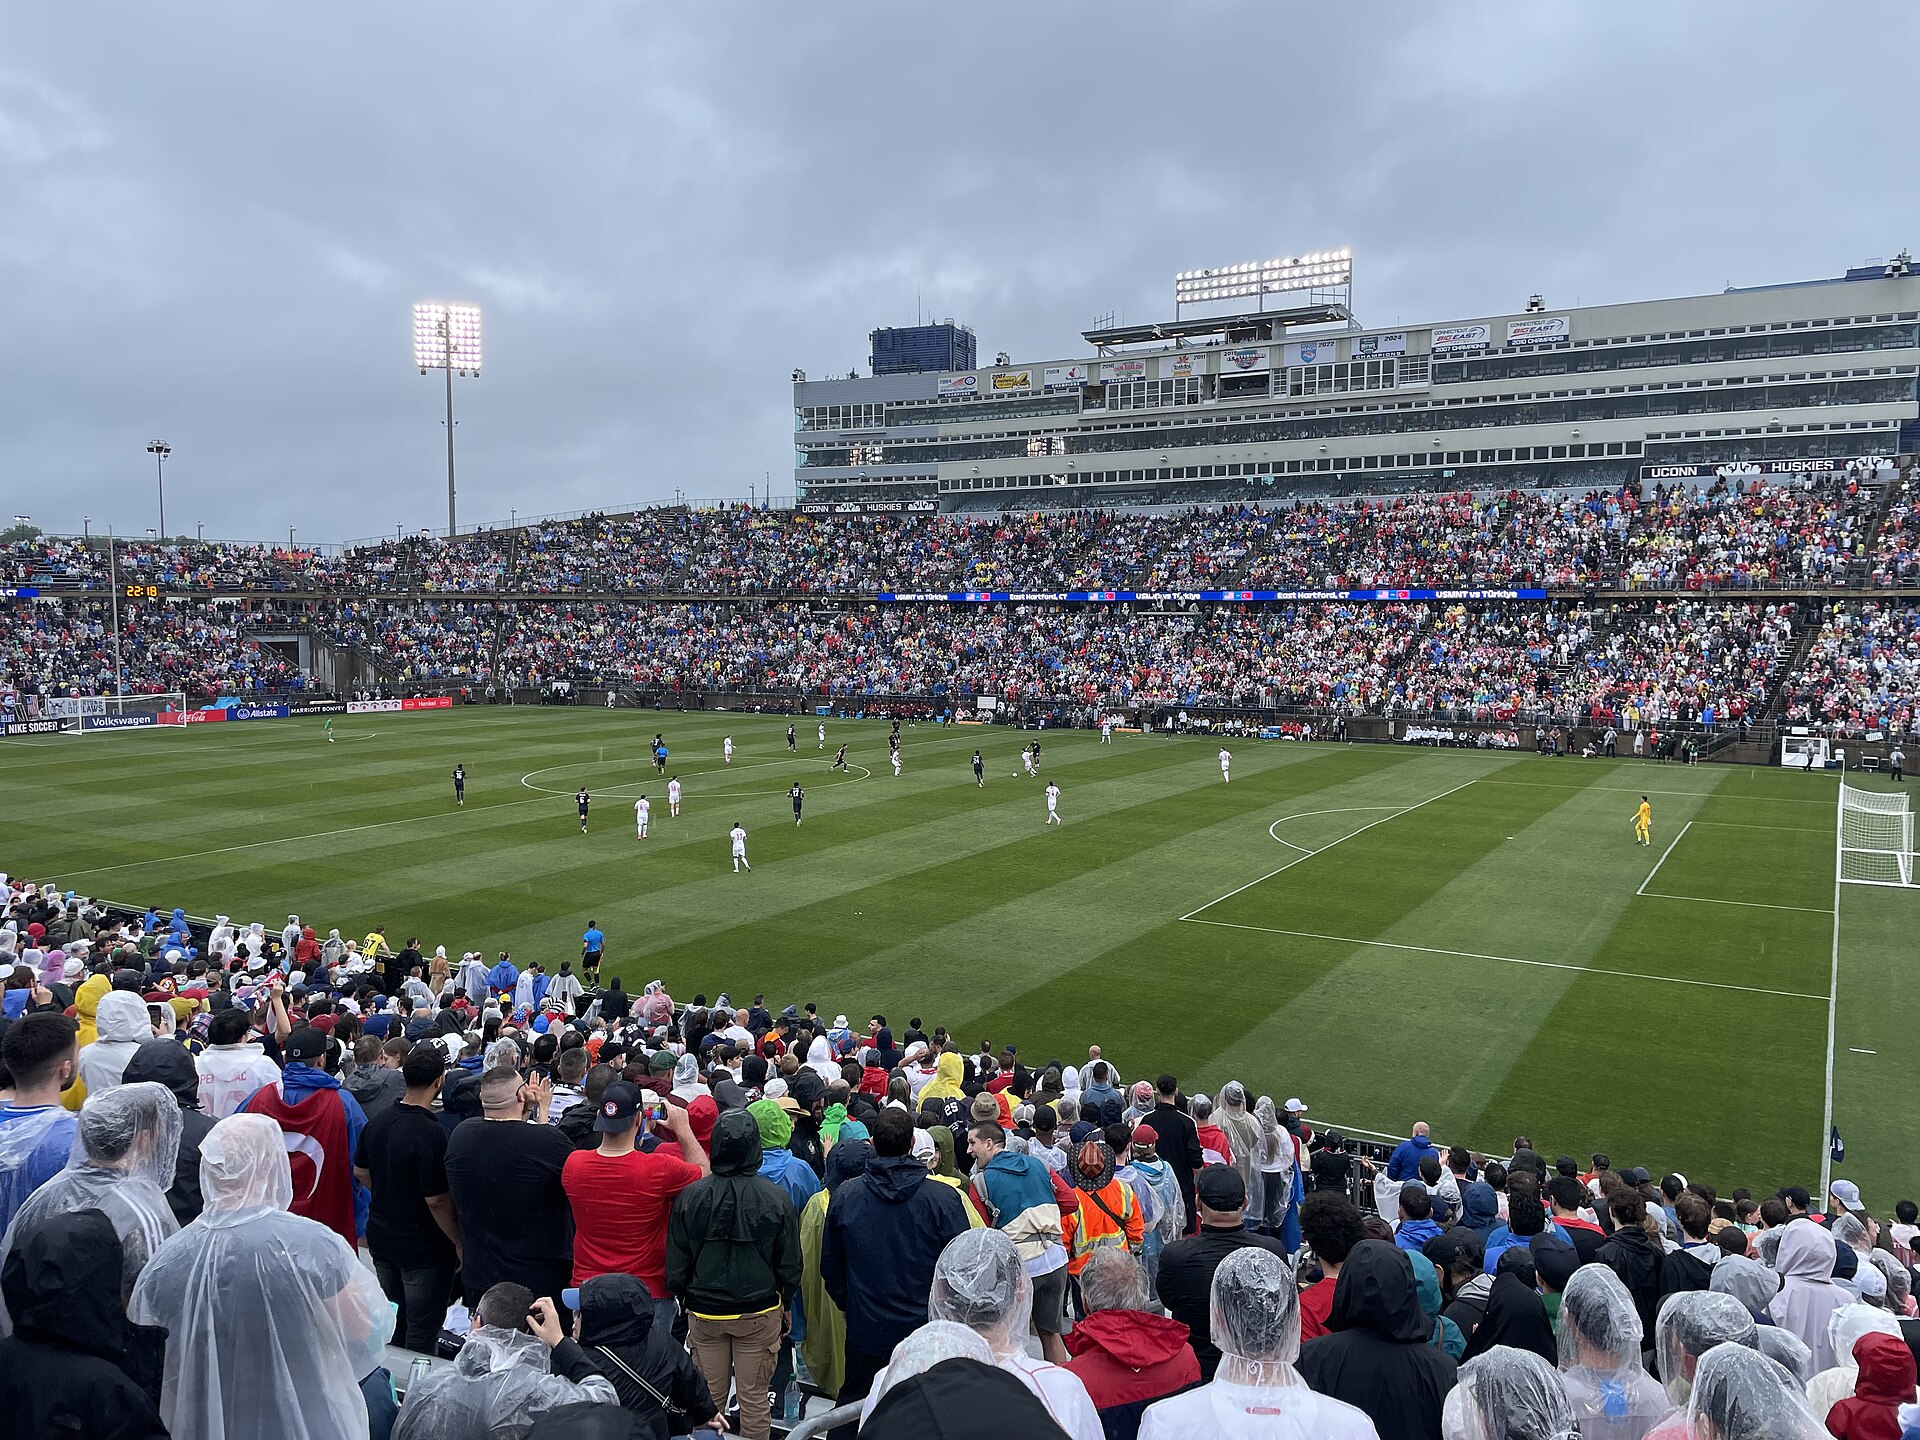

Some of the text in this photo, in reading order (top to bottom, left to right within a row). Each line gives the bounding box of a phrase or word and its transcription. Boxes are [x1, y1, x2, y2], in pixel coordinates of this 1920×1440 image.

[1528, 336, 1564, 344] CHAMPIONS
[1356, 352, 1402, 360] CHAMPIONS
[1651, 460, 1834, 478] UCONN HUSKIES
[126, 586, 158, 597] 22:18
[1298, 591, 1338, 600] Hartford,
[1436, 590, 1468, 598] USMNT
[1482, 590, 1518, 599] Türkiye
[1026, 593, 1058, 601] Hartford,
[250, 708, 278, 718] Allstate
[92, 716, 150, 727] Volkswagen
[8, 723, 28, 734] NIKE
[28, 722, 58, 733] SOCCER
[364, 939, 376, 949] 67
[164, 980, 172, 988] S
[944, 1102, 958, 1116] 25
